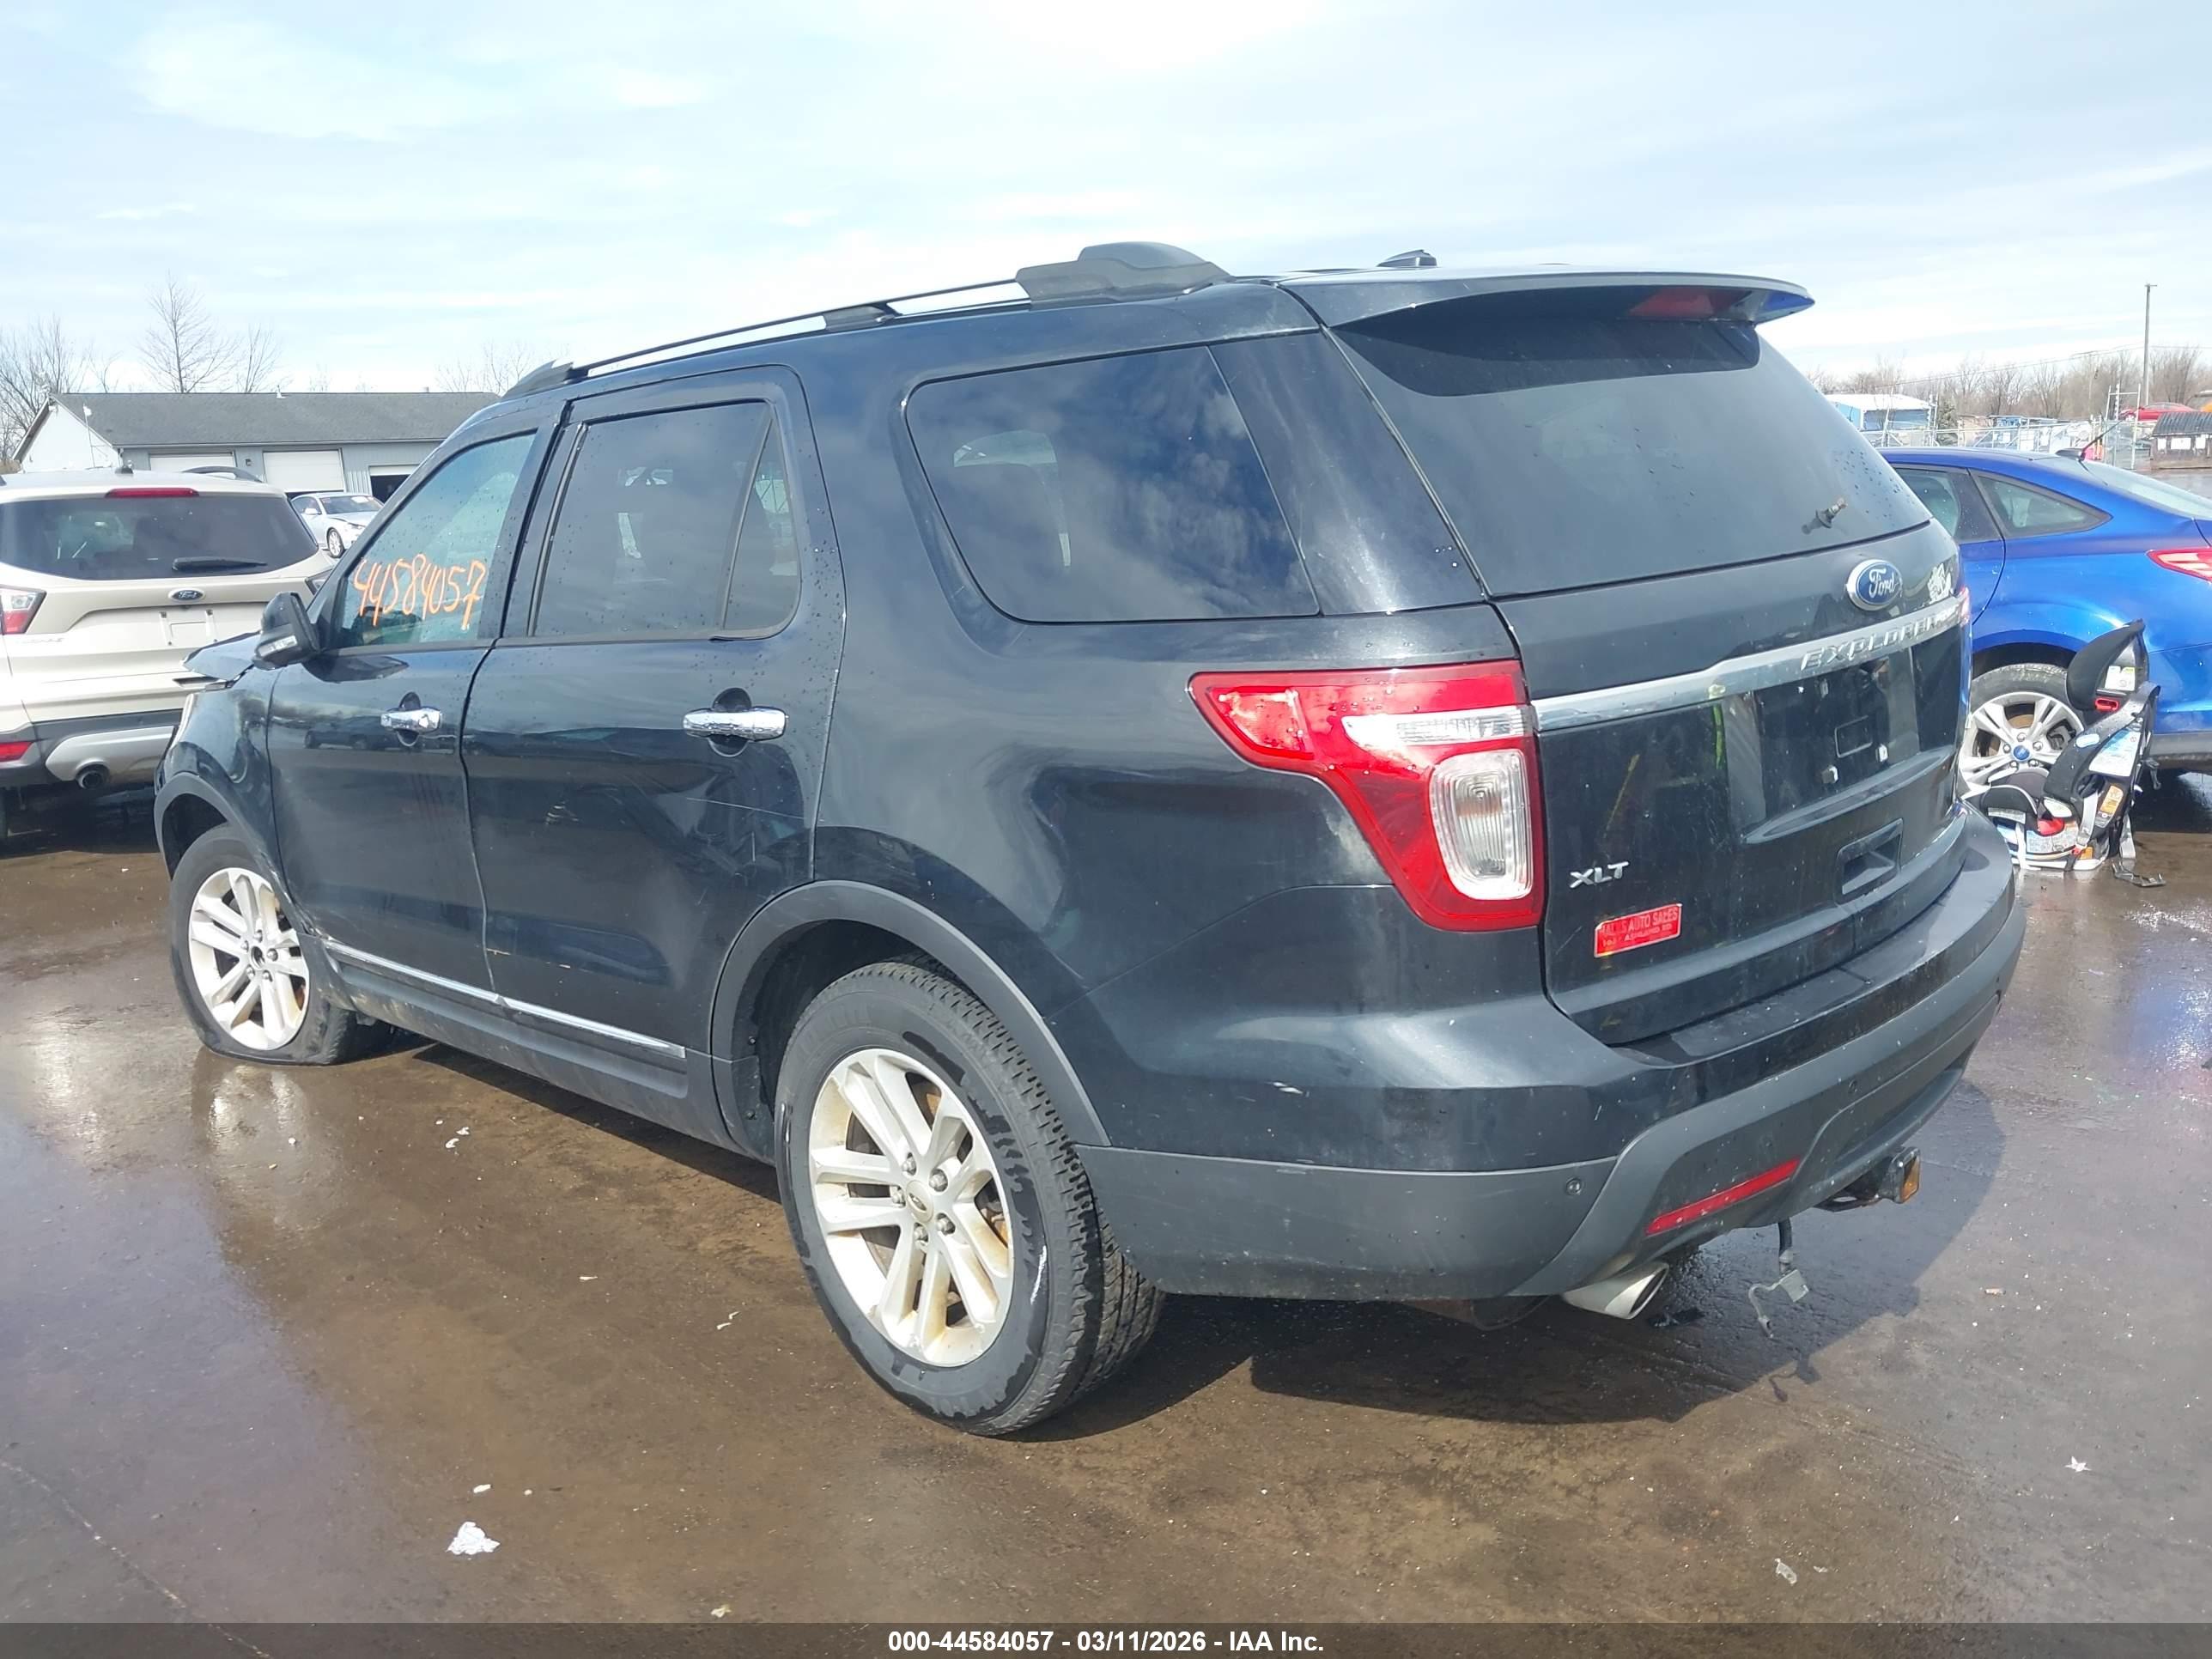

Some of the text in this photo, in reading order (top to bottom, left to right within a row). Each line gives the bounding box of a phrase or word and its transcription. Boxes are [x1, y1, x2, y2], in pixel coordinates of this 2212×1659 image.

[353, 553, 487, 630] 44584057
[1868, 568, 1898, 599] Ford
[1569, 860, 1630, 889] XLT
[1627, 914, 1651, 932] AUTO
[1652, 907, 1678, 926] SALES
